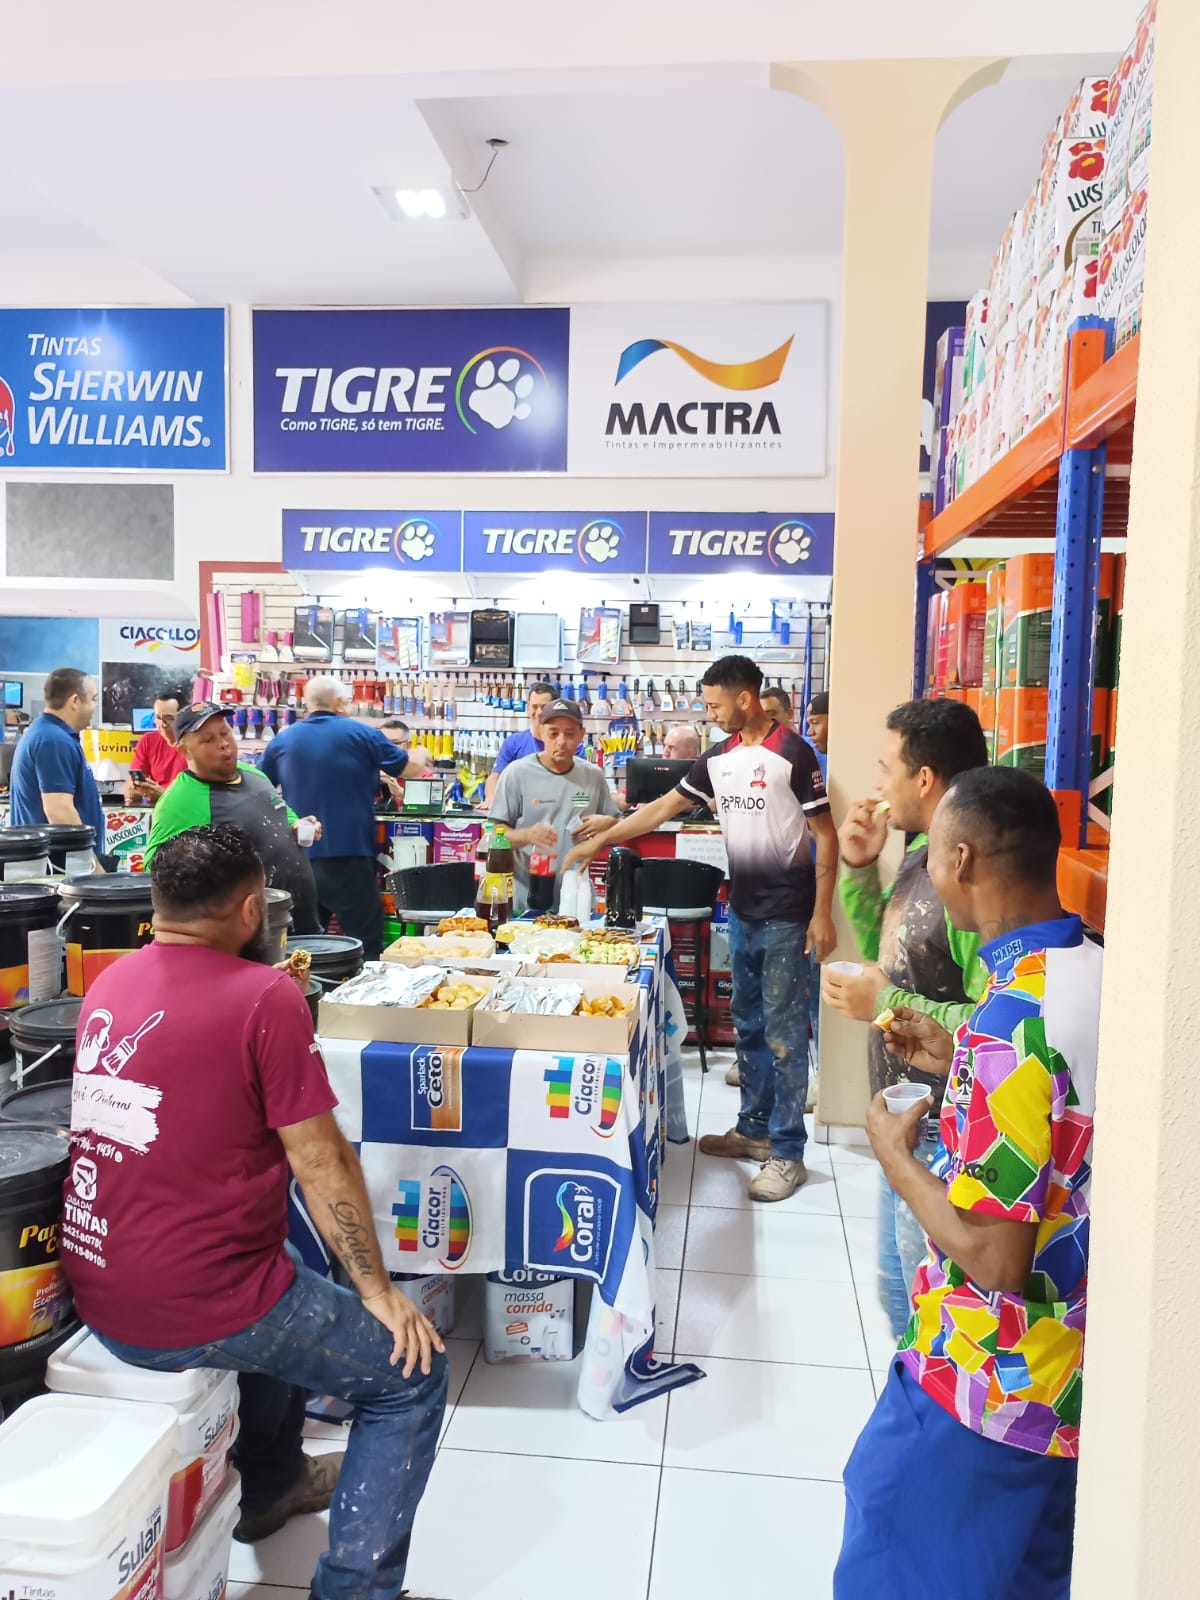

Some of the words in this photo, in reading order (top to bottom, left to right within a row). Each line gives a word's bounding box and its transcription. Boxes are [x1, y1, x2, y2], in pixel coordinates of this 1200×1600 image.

[27, 333, 102, 356] TINTAS
[29, 362, 203, 402] SHERWIN
[275, 367, 452, 413] TIGRE
[280, 418, 317, 432] Como
[319, 418, 359, 433] TIGRE,
[361, 418, 376, 431] só
[378, 418, 402, 431] tem
[405, 418, 445, 431] TIGRE.
[605, 402, 781, 435] MACTRA
[605, 441, 639, 449] Tintas
[653, 441, 782, 450] Impermeabilizantes
[301, 527, 393, 553] TIGRE
[483, 529, 577, 554] TIGRE
[669, 530, 767, 555] TIGRE
[992, 939, 1023, 966] MAPEI
[417, 1056, 429, 1095] Sparlack
[64, 1202, 108, 1236] TINTAS
[422, 1187, 441, 1249] Ciacor
[570, 1194, 594, 1262] Coral
[505, 1292, 544, 1303] massa
[506, 1301, 553, 1314] corrida
[118, 1515, 162, 1585] Sulan
